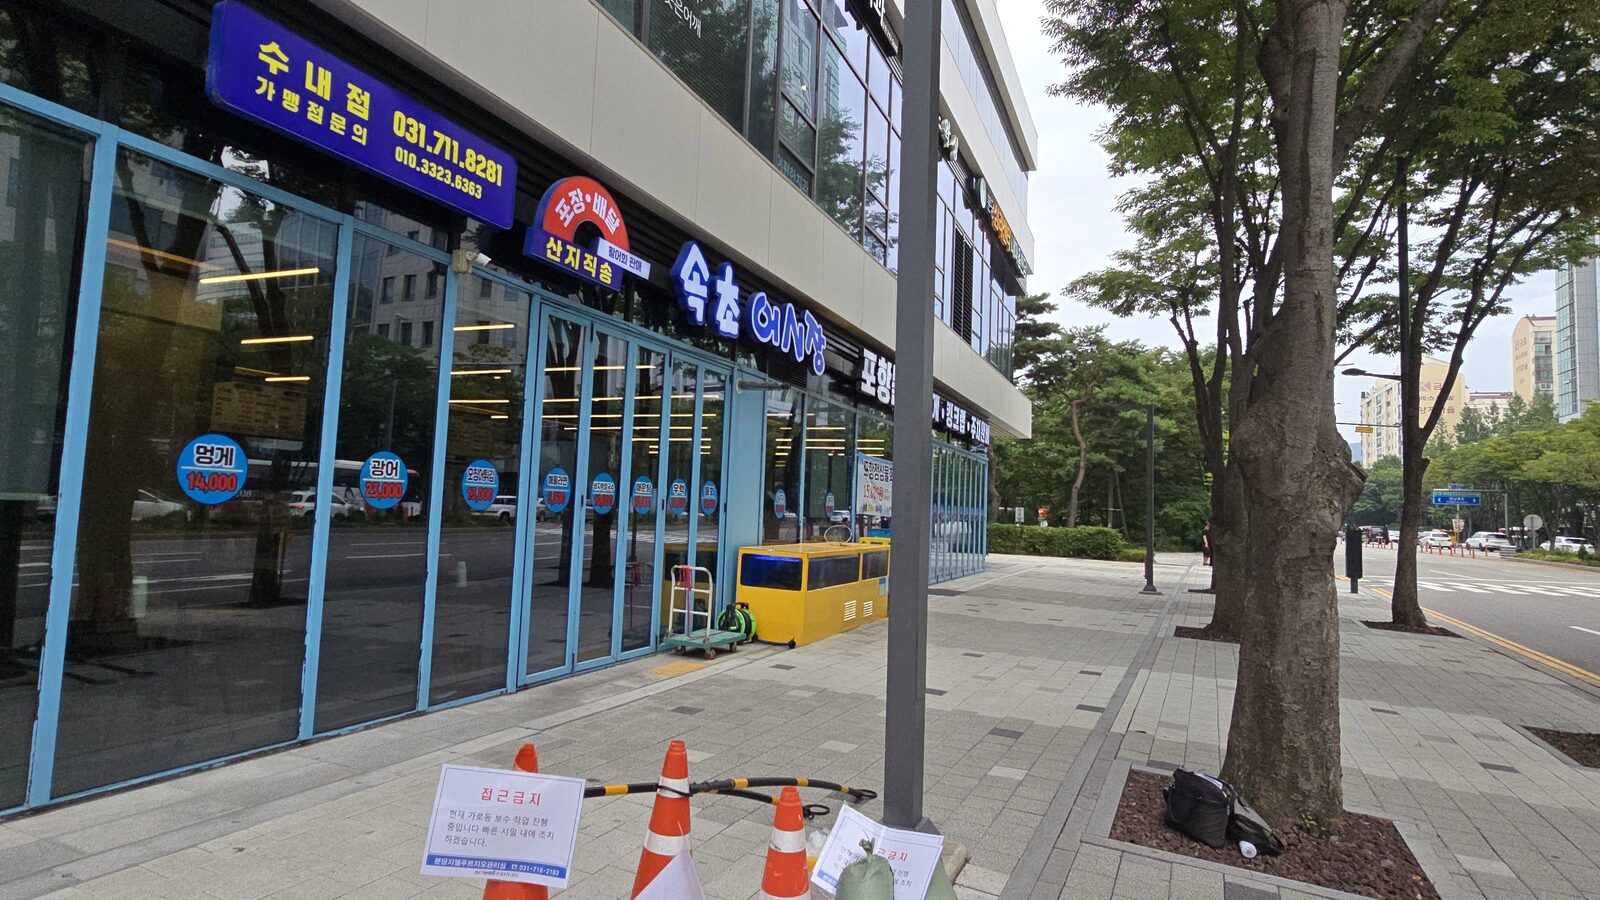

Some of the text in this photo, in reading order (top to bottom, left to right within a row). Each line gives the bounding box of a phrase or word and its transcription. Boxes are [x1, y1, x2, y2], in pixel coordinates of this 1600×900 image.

[255, 75, 368, 146] 가맹점문의
[392, 110, 503, 187] 031.711.8281
[394, 146, 483, 199] 010.3323.6363
[546, 236, 613, 285] 산지직송
[679, 242, 827, 376] 속초 어시장
[861, 347, 896, 407] 포항
[195, 443, 236, 467] 멍게
[370, 459, 400, 478] 광어
[187, 472, 238, 493] 14,000
[364, 483, 403, 500] 23,000
[673, 483, 685, 494] 우럭
[480, 787, 542, 807] 접근금지
[449, 809, 549, 827] 현재 가로등 보수 작업 진행
[447, 822, 479, 834] 중입니다
[482, 826, 498, 836] 빠른
[501, 827, 517, 837] 시일
[520, 829, 536, 838] 내에
